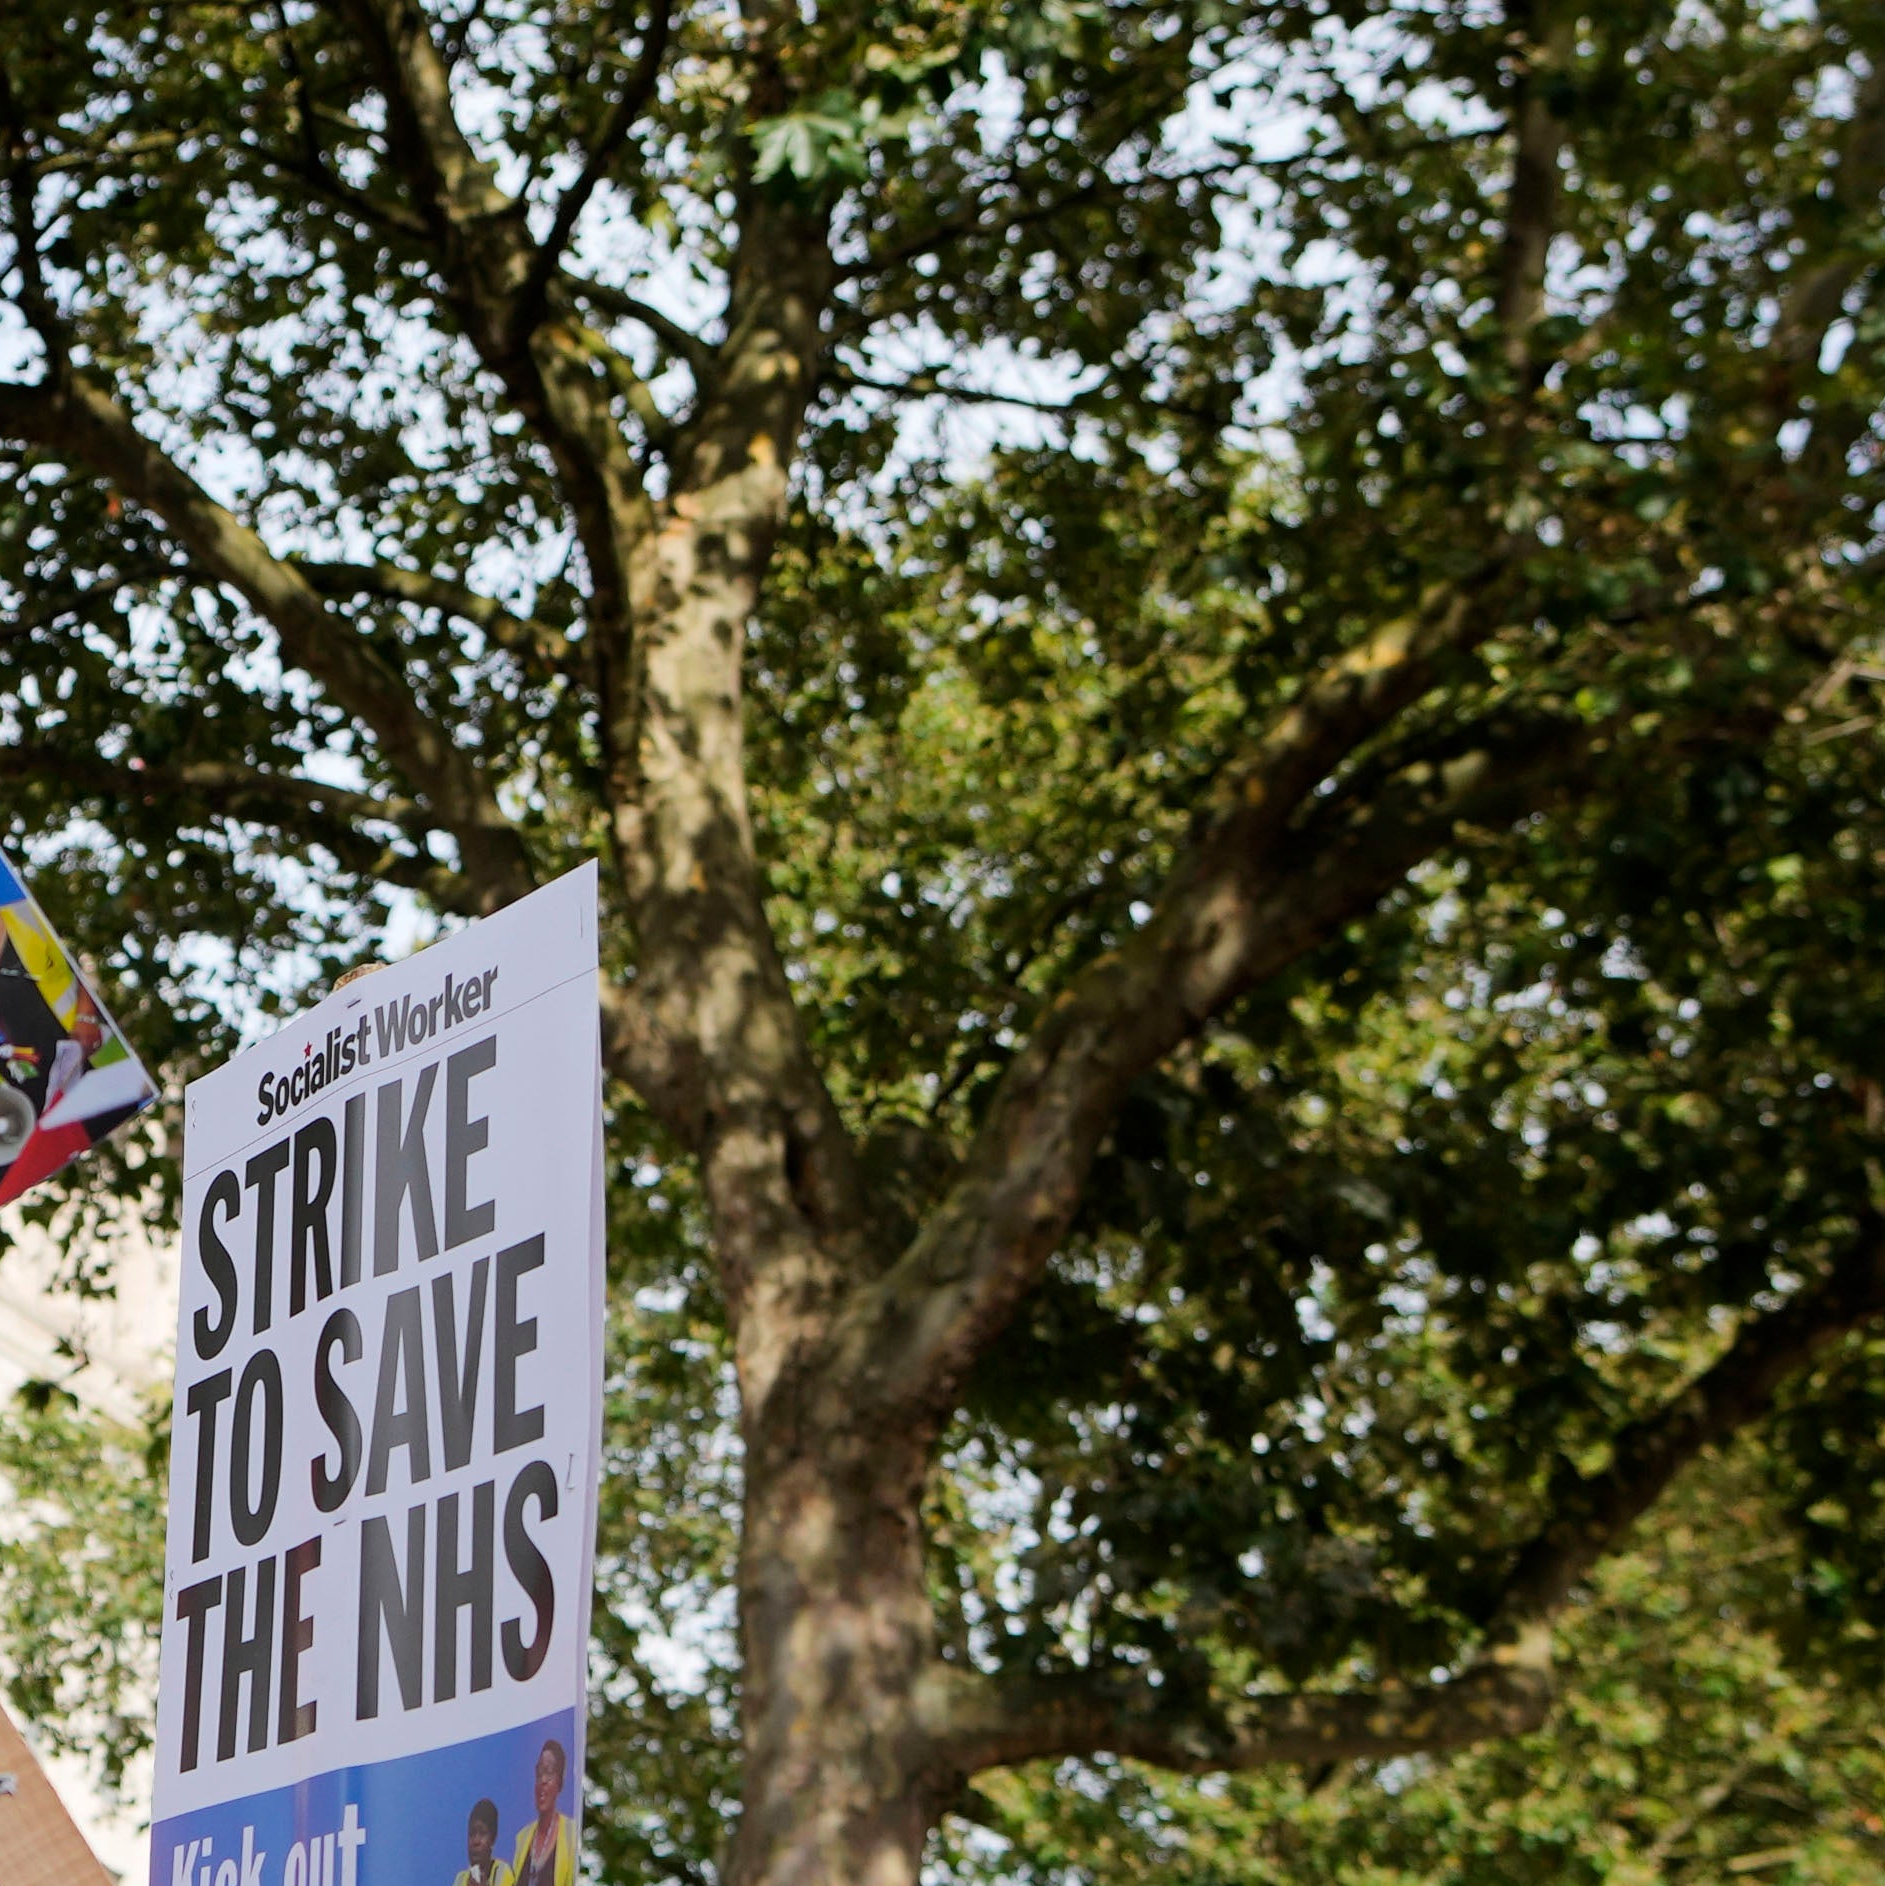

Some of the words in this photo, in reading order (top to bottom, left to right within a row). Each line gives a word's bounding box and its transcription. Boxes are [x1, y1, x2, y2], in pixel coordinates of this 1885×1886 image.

[193, 1034, 498, 1362] STRIKE
[256, 1014, 371, 1127] Socialist
[375, 964, 499, 1058] Worker
[186, 1348, 283, 1564] TO
[310, 1231, 545, 1512] SAVE
[176, 1535, 321, 1774] THE
[356, 1460, 559, 1721] NHS
